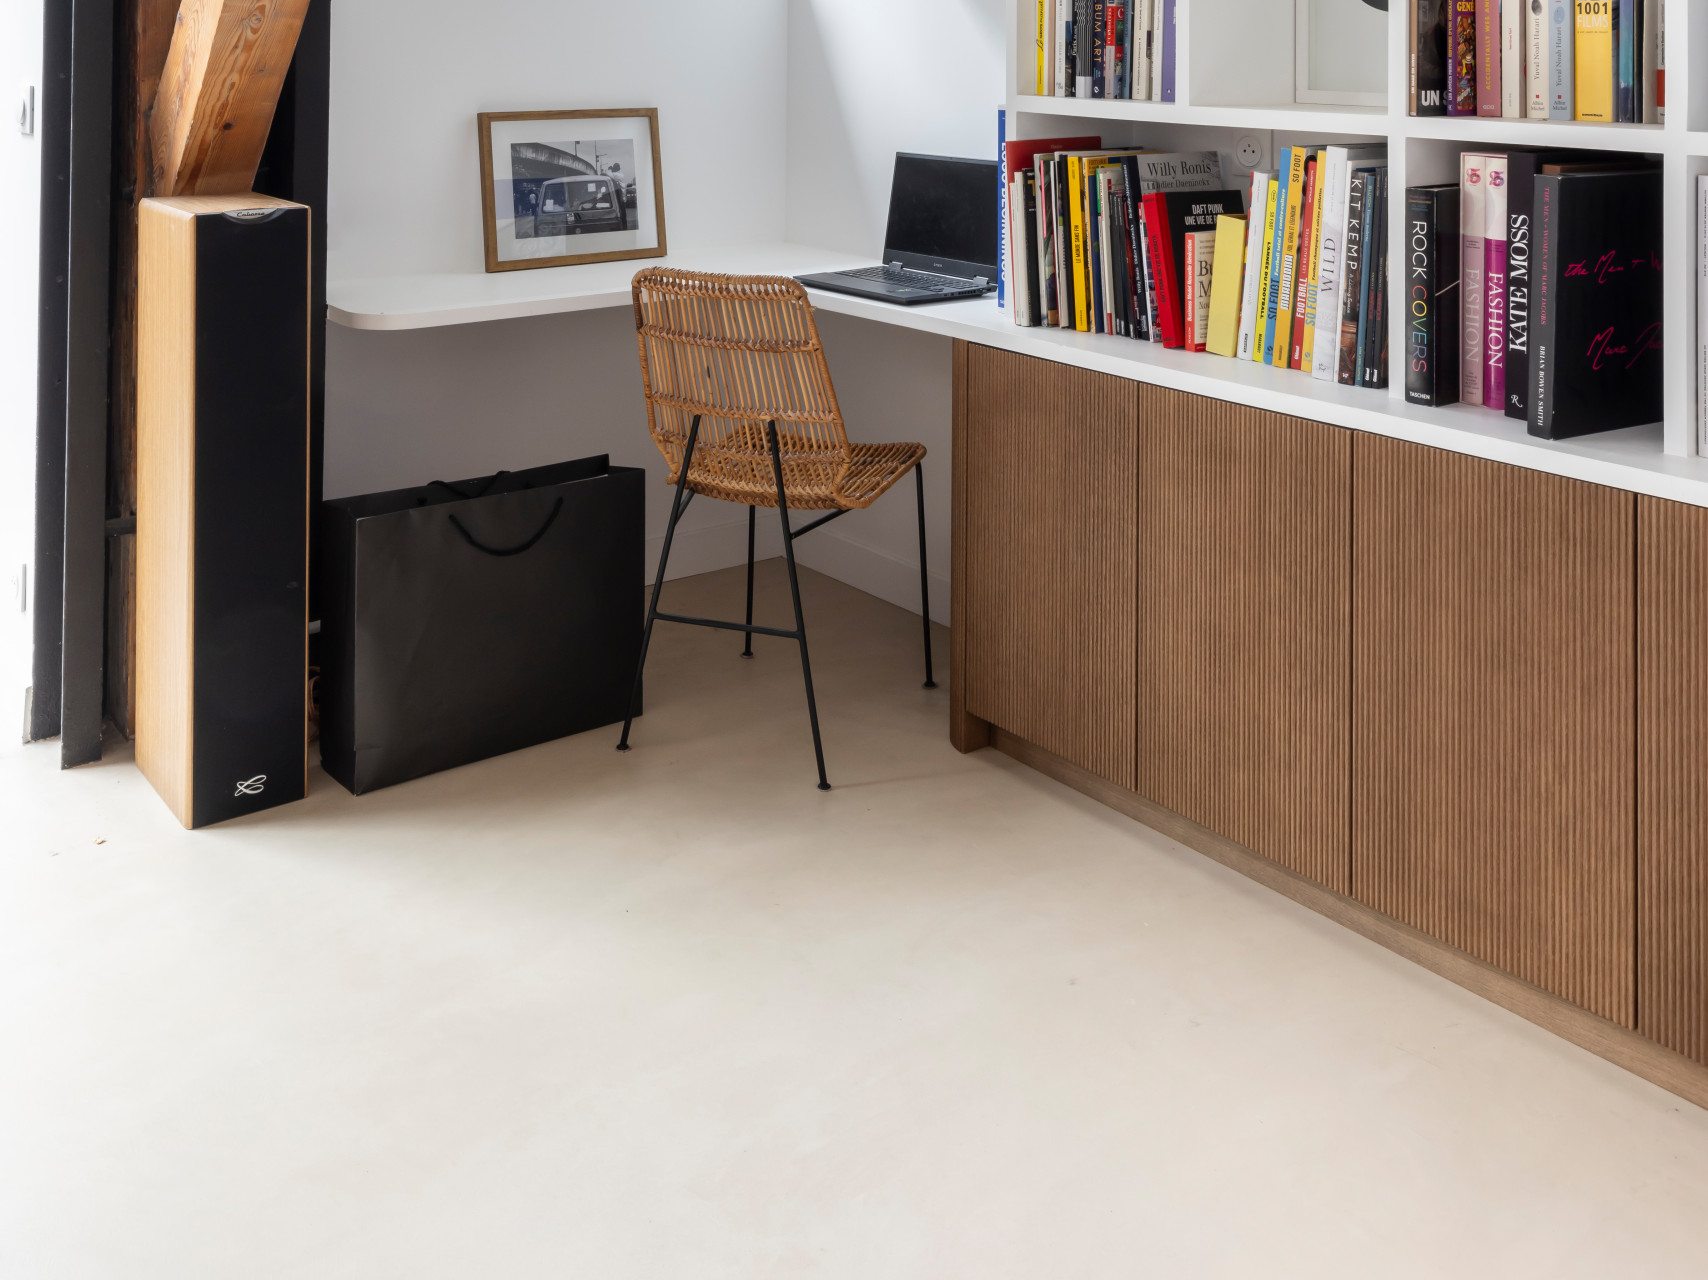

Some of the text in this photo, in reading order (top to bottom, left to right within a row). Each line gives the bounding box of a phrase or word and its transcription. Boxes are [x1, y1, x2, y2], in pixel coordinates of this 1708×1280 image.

[1577, 2, 1608, 14] 1001
[1577, 15, 1609, 28] FILMS
[1554, 26, 1562, 47] Harari
[1092, 38, 1101, 63] ART
[1554, 49, 1562, 67] Noah
[1421, 90, 1440, 106] UN
[1147, 159, 1212, 179] Willy Ronis
[1291, 153, 1302, 183] SO FOOT
[1175, 177, 1211, 188] Daeninckx
[1542, 187, 1550, 203] THE
[1185, 215, 1214, 225] UNE VIE DE
[1192, 204, 1224, 214] DAFT PUNK
[1277, 188, 1286, 229] contre-culture
[1346, 179, 1362, 270] KIT KEMP
[1412, 221, 1427, 279] ROCK
[1541, 229, 1549, 260] WOMEN
[1263, 271, 1268, 282] DU
[1316, 236, 1340, 293] WILD
[1541, 261, 1548, 272] OF
[1135, 280, 1143, 293] Willy
[1267, 277, 1280, 304] FOOT
[1277, 252, 1296, 310] MARADONA
[1509, 214, 1530, 354] KATE MOSS
[1540, 274, 1548, 296] MARC
[1259, 282, 1267, 320] FOOTBALL
[1295, 276, 1307, 318] FOOTBALL
[1305, 282, 1318, 310] FOOT
[1266, 305, 1277, 320] SO
[1305, 310, 1316, 326] SO
[1464, 269, 1480, 363] FASHION
[1487, 272, 1504, 368] FASHION
[1539, 297, 1547, 325] JACOBS
[1412, 285, 1427, 373] COVERS
[1409, 391, 1431, 400] TASCHEN
[1537, 370, 1545, 399] BOWEN
[1536, 400, 1544, 426] SMITH
